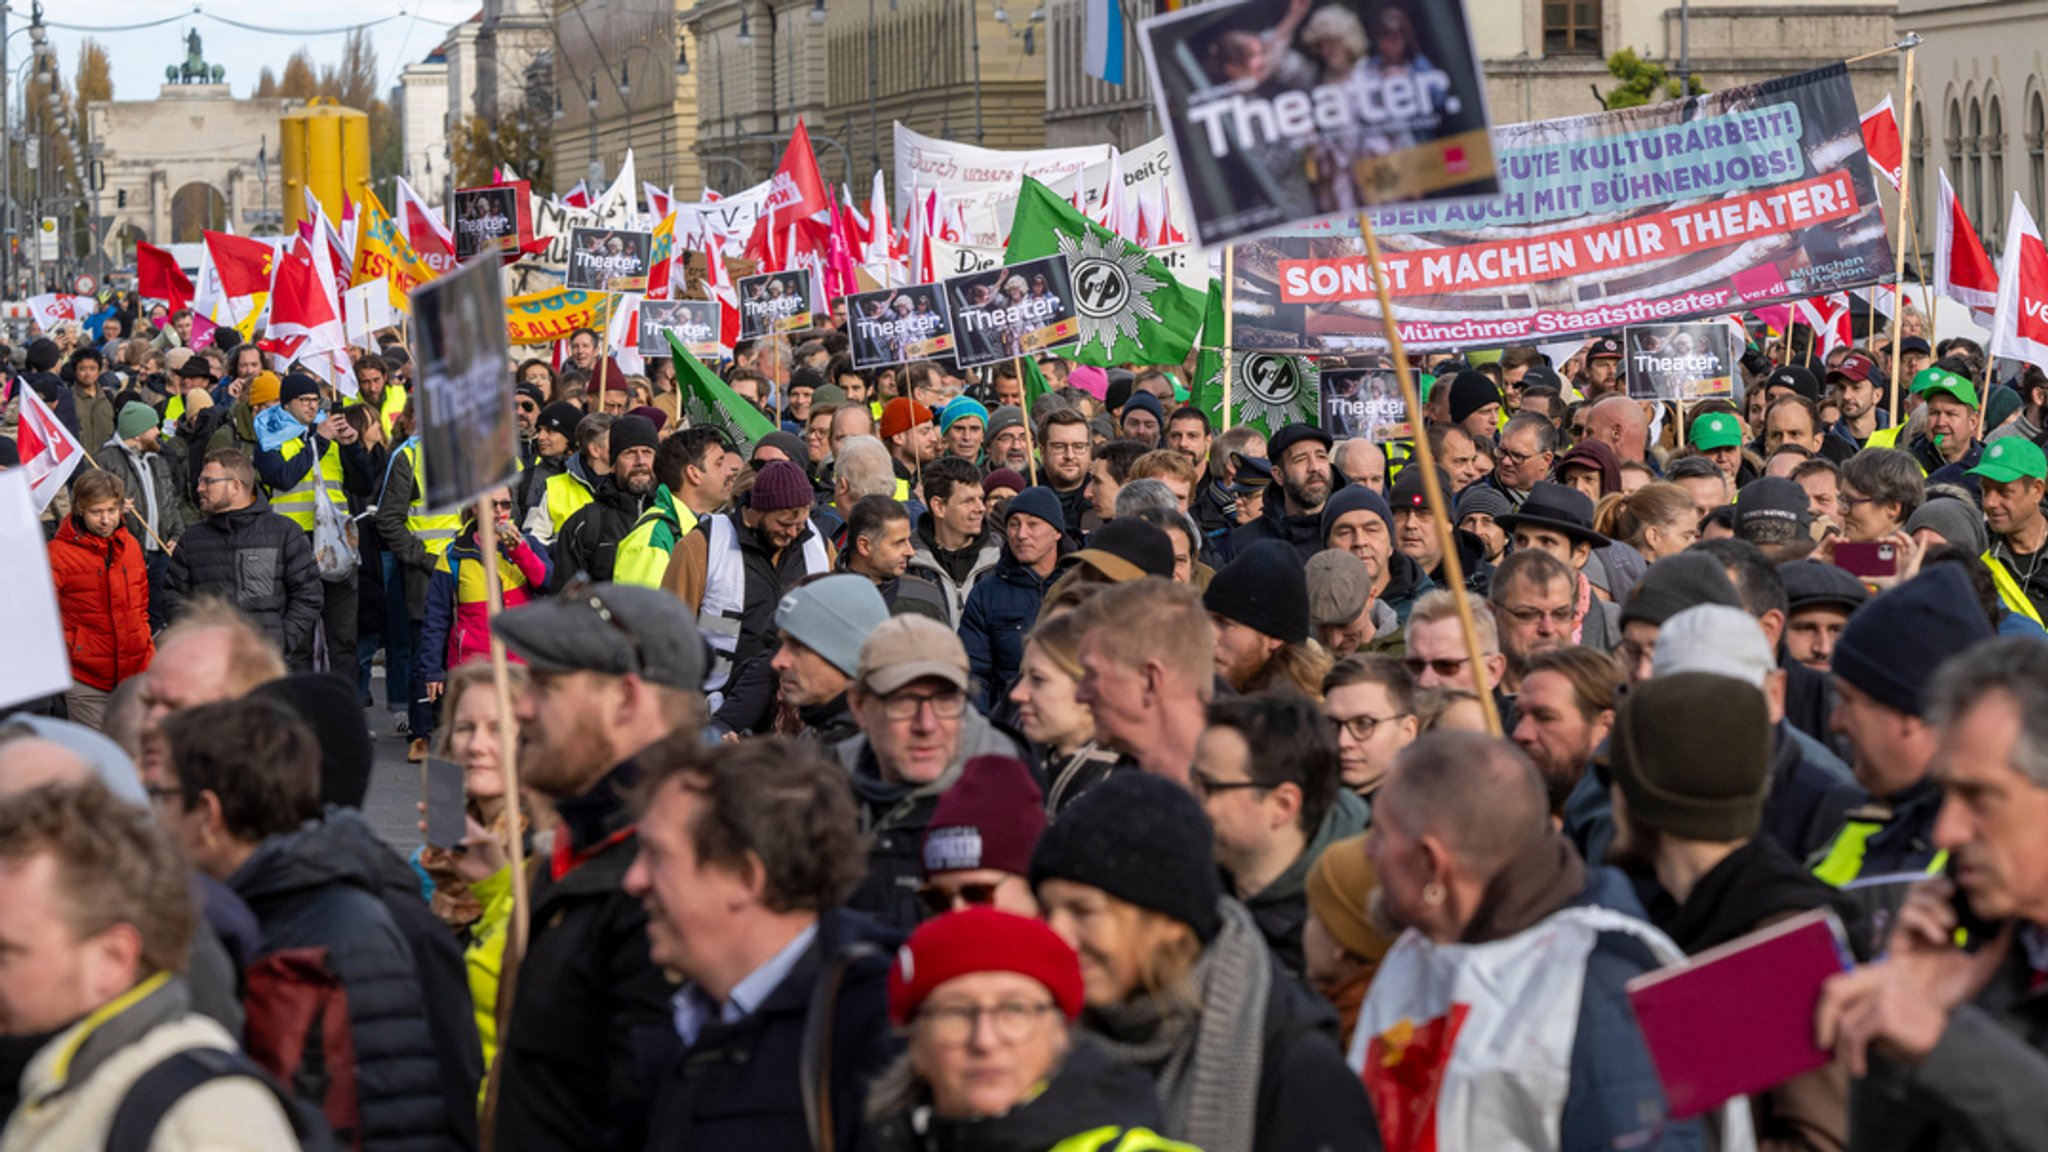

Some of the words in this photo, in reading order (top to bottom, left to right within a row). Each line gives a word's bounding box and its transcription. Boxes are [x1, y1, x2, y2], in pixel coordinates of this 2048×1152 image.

[1569, 110, 1795, 172] KULTURARBEIT!
[1444, 191, 1524, 223] AUCH
[1534, 184, 1582, 214] MIT
[1590, 147, 1797, 206] BÜHNENJOBS!
[1285, 260, 1410, 297] SONST
[1421, 238, 1577, 288] MACHEN
[1583, 222, 1665, 264] WIR
[1671, 178, 1850, 246] THEATER!
[574, 250, 643, 272] Theater.
[954, 249, 995, 273] Die
[744, 295, 805, 316] Theater.
[959, 297, 1065, 332] Theater.
[1395, 318, 1531, 342] Münchner
[1536, 287, 1731, 332] Staatstheater
[857, 313, 945, 339] Theater.
[1633, 354, 1723, 373] Theater.
